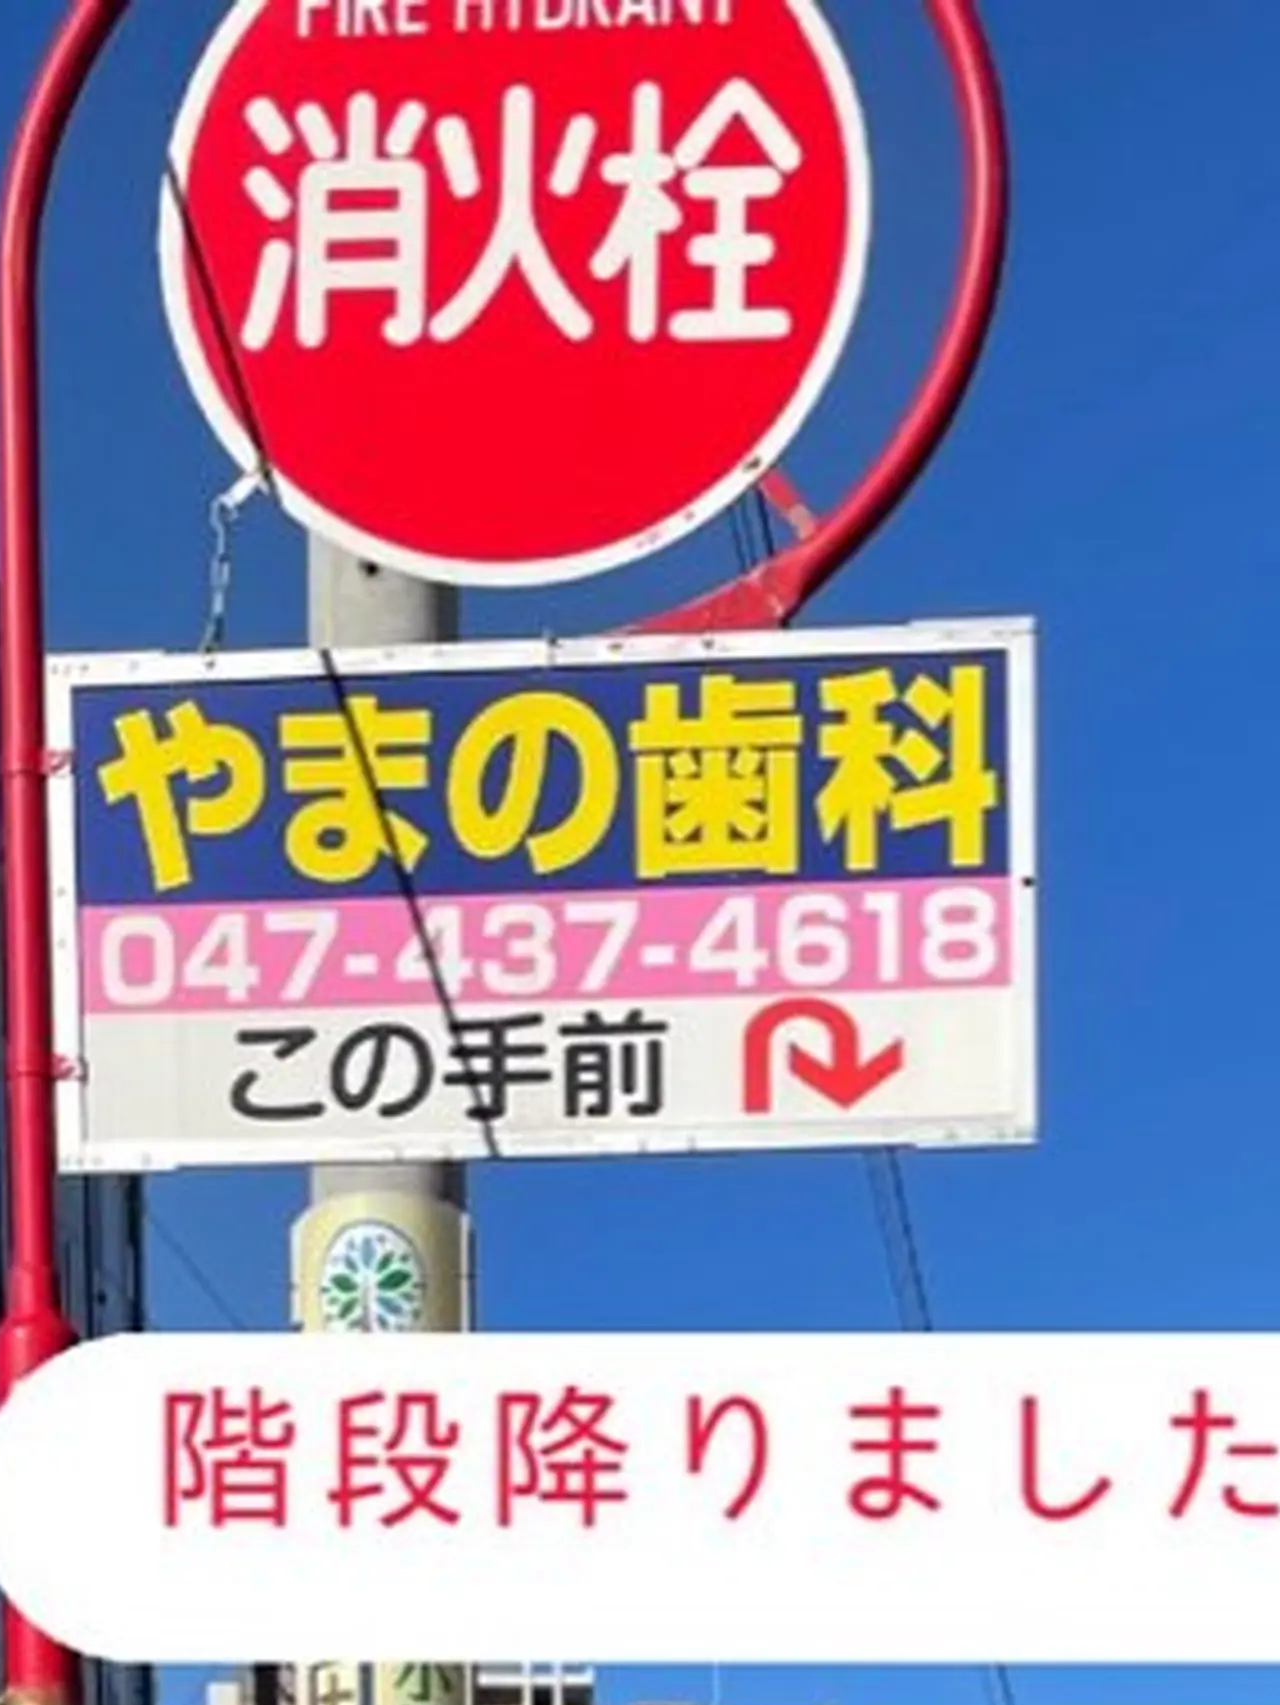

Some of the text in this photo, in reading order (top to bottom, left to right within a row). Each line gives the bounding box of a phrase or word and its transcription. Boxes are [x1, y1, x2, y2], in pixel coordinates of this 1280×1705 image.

[296, 0, 429, 39] FIRE
[239, 79, 803, 353] 消火栓
[97, 664, 998, 893] やまの歯科
[100, 886, 998, 1007] 047-437-4618
[229, 1008, 669, 1124] この手前
